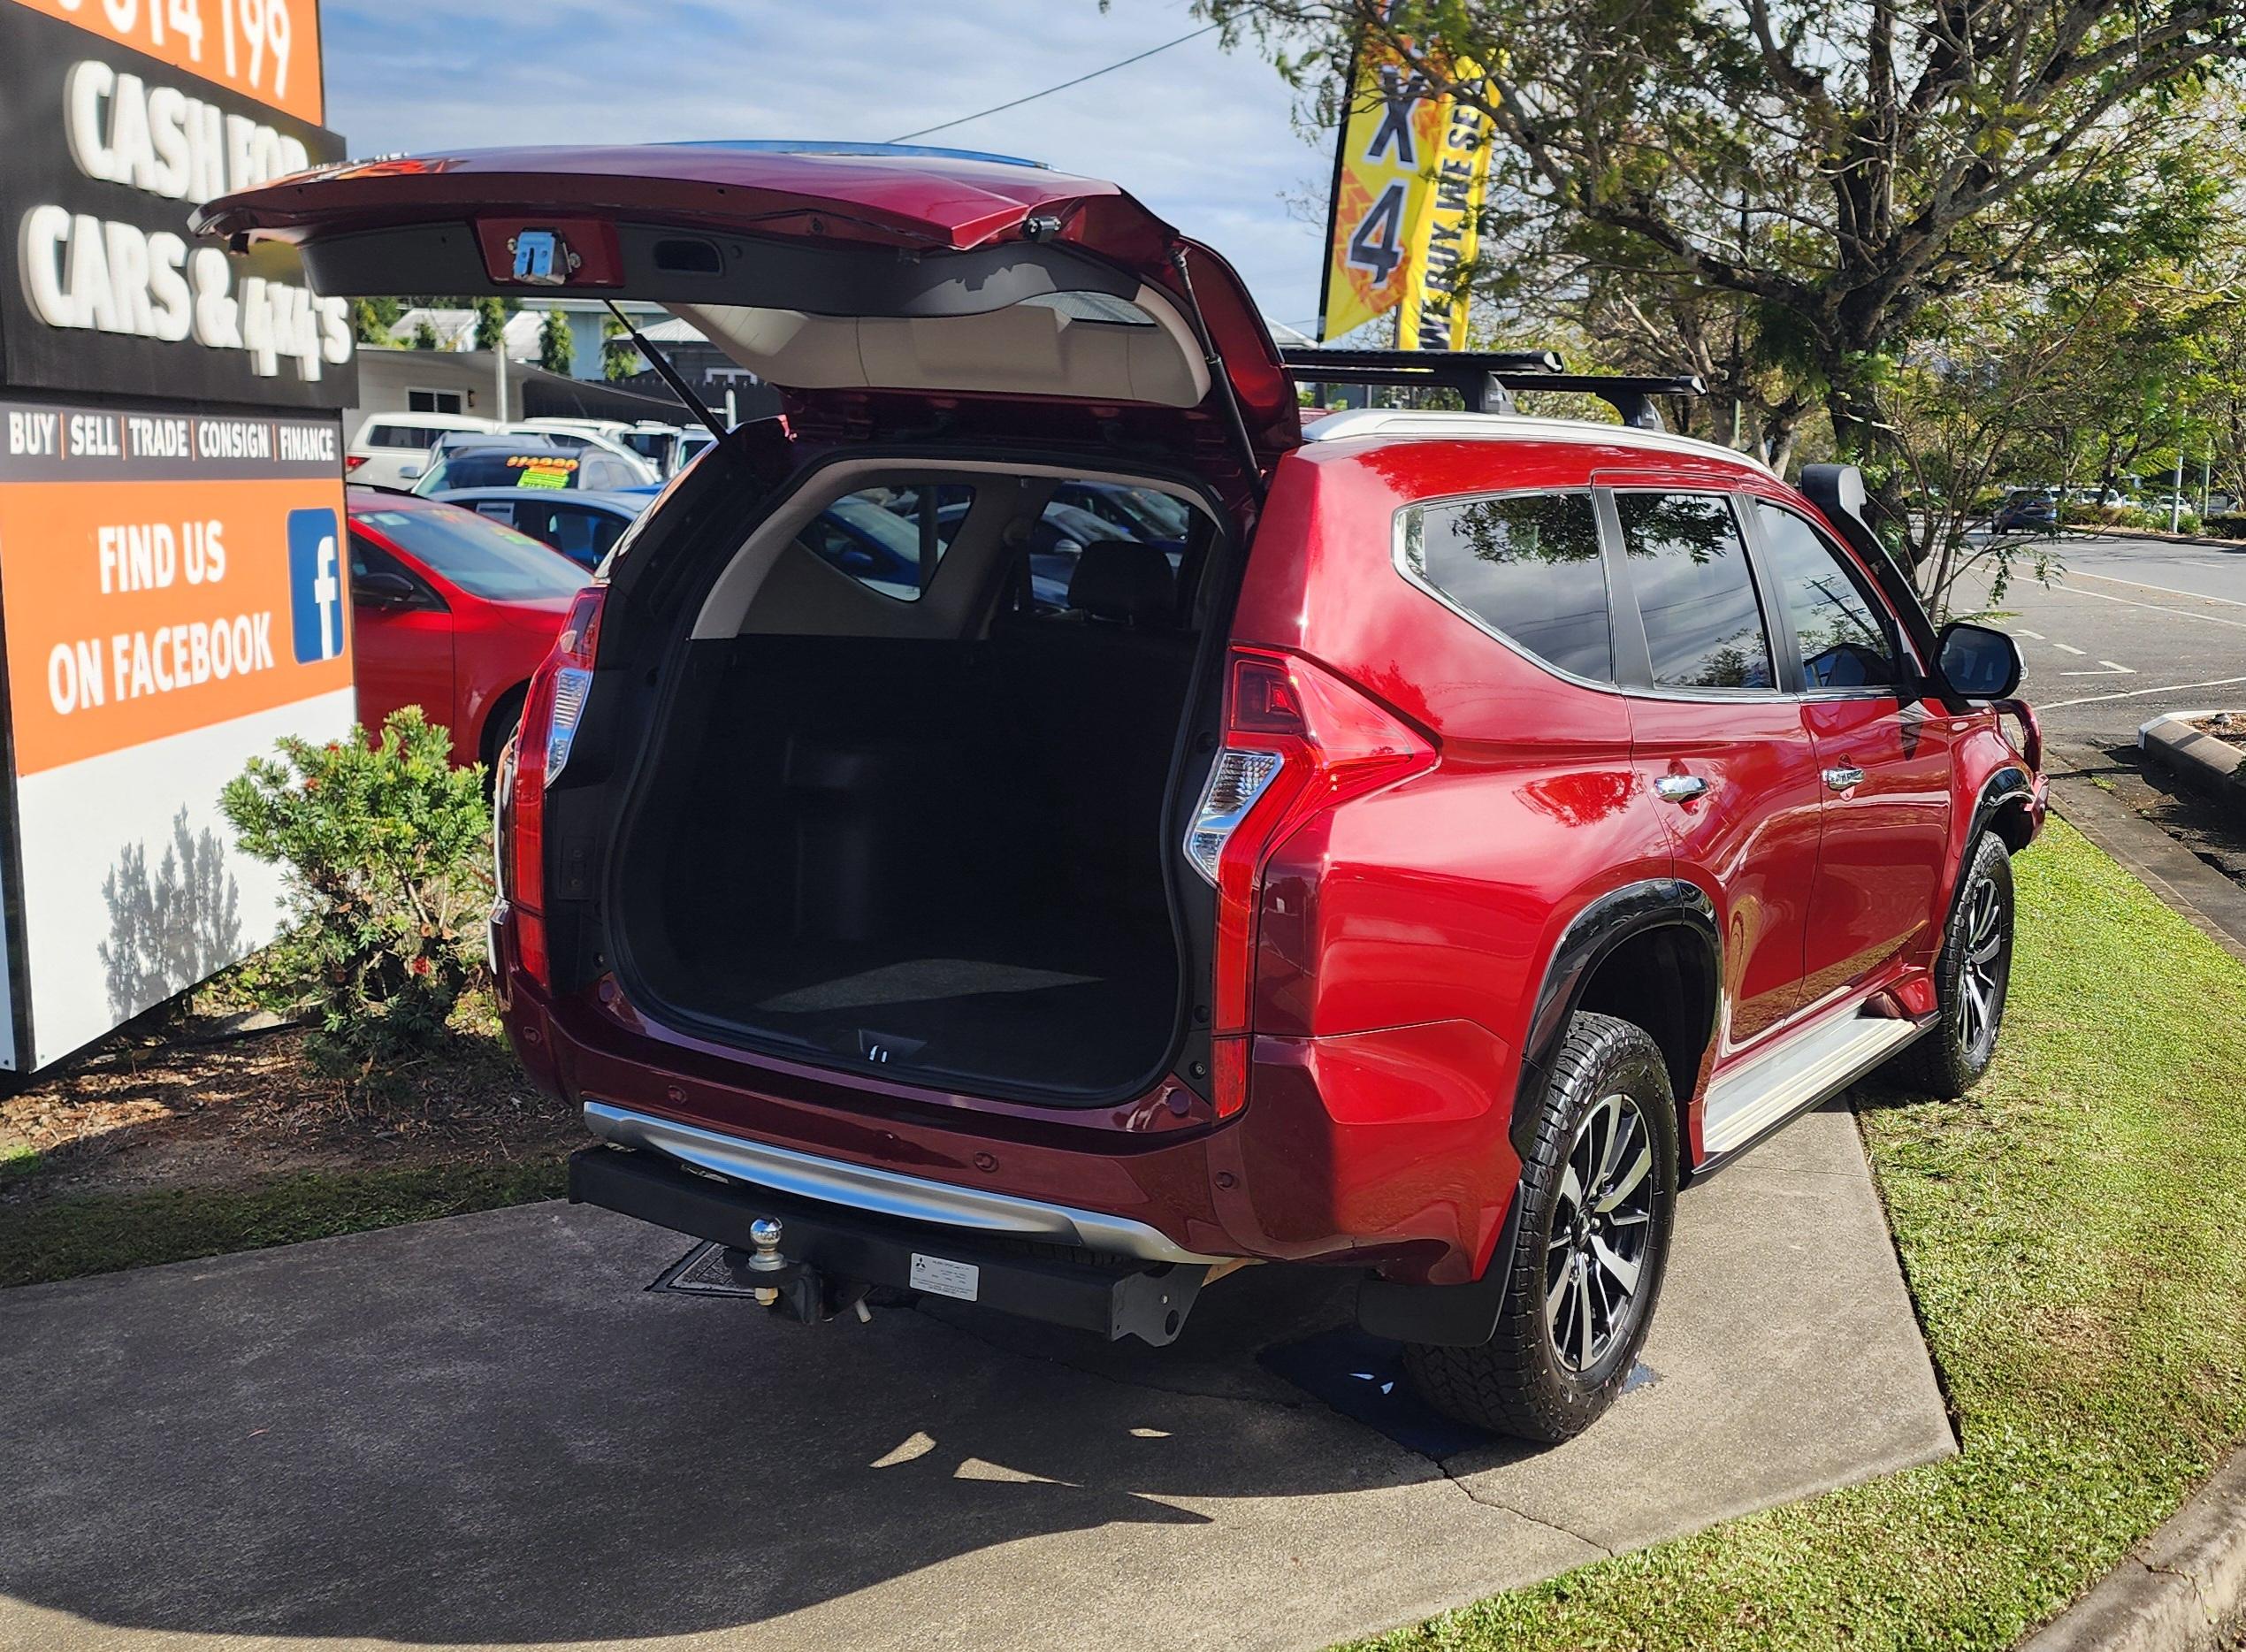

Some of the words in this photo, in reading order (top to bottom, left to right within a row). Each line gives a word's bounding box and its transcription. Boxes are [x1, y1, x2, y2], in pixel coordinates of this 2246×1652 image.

[220, 0, 292, 100] 199
[65, 60, 225, 204] CASH
[1434, 158, 1473, 210] WE
[19, 205, 191, 342] CARS
[187, 248, 245, 348] &
[9, 411, 57, 455] BUY
[70, 414, 118, 456] SELL
[129, 417, 189, 458] TRADE
[198, 422, 269, 459] CONSIGN
[279, 427, 335, 461] FINANCE
[98, 523, 176, 594] FIND
[182, 520, 226, 585] US
[48, 638, 104, 715] ON
[111, 611, 275, 701] FACEBOOK
